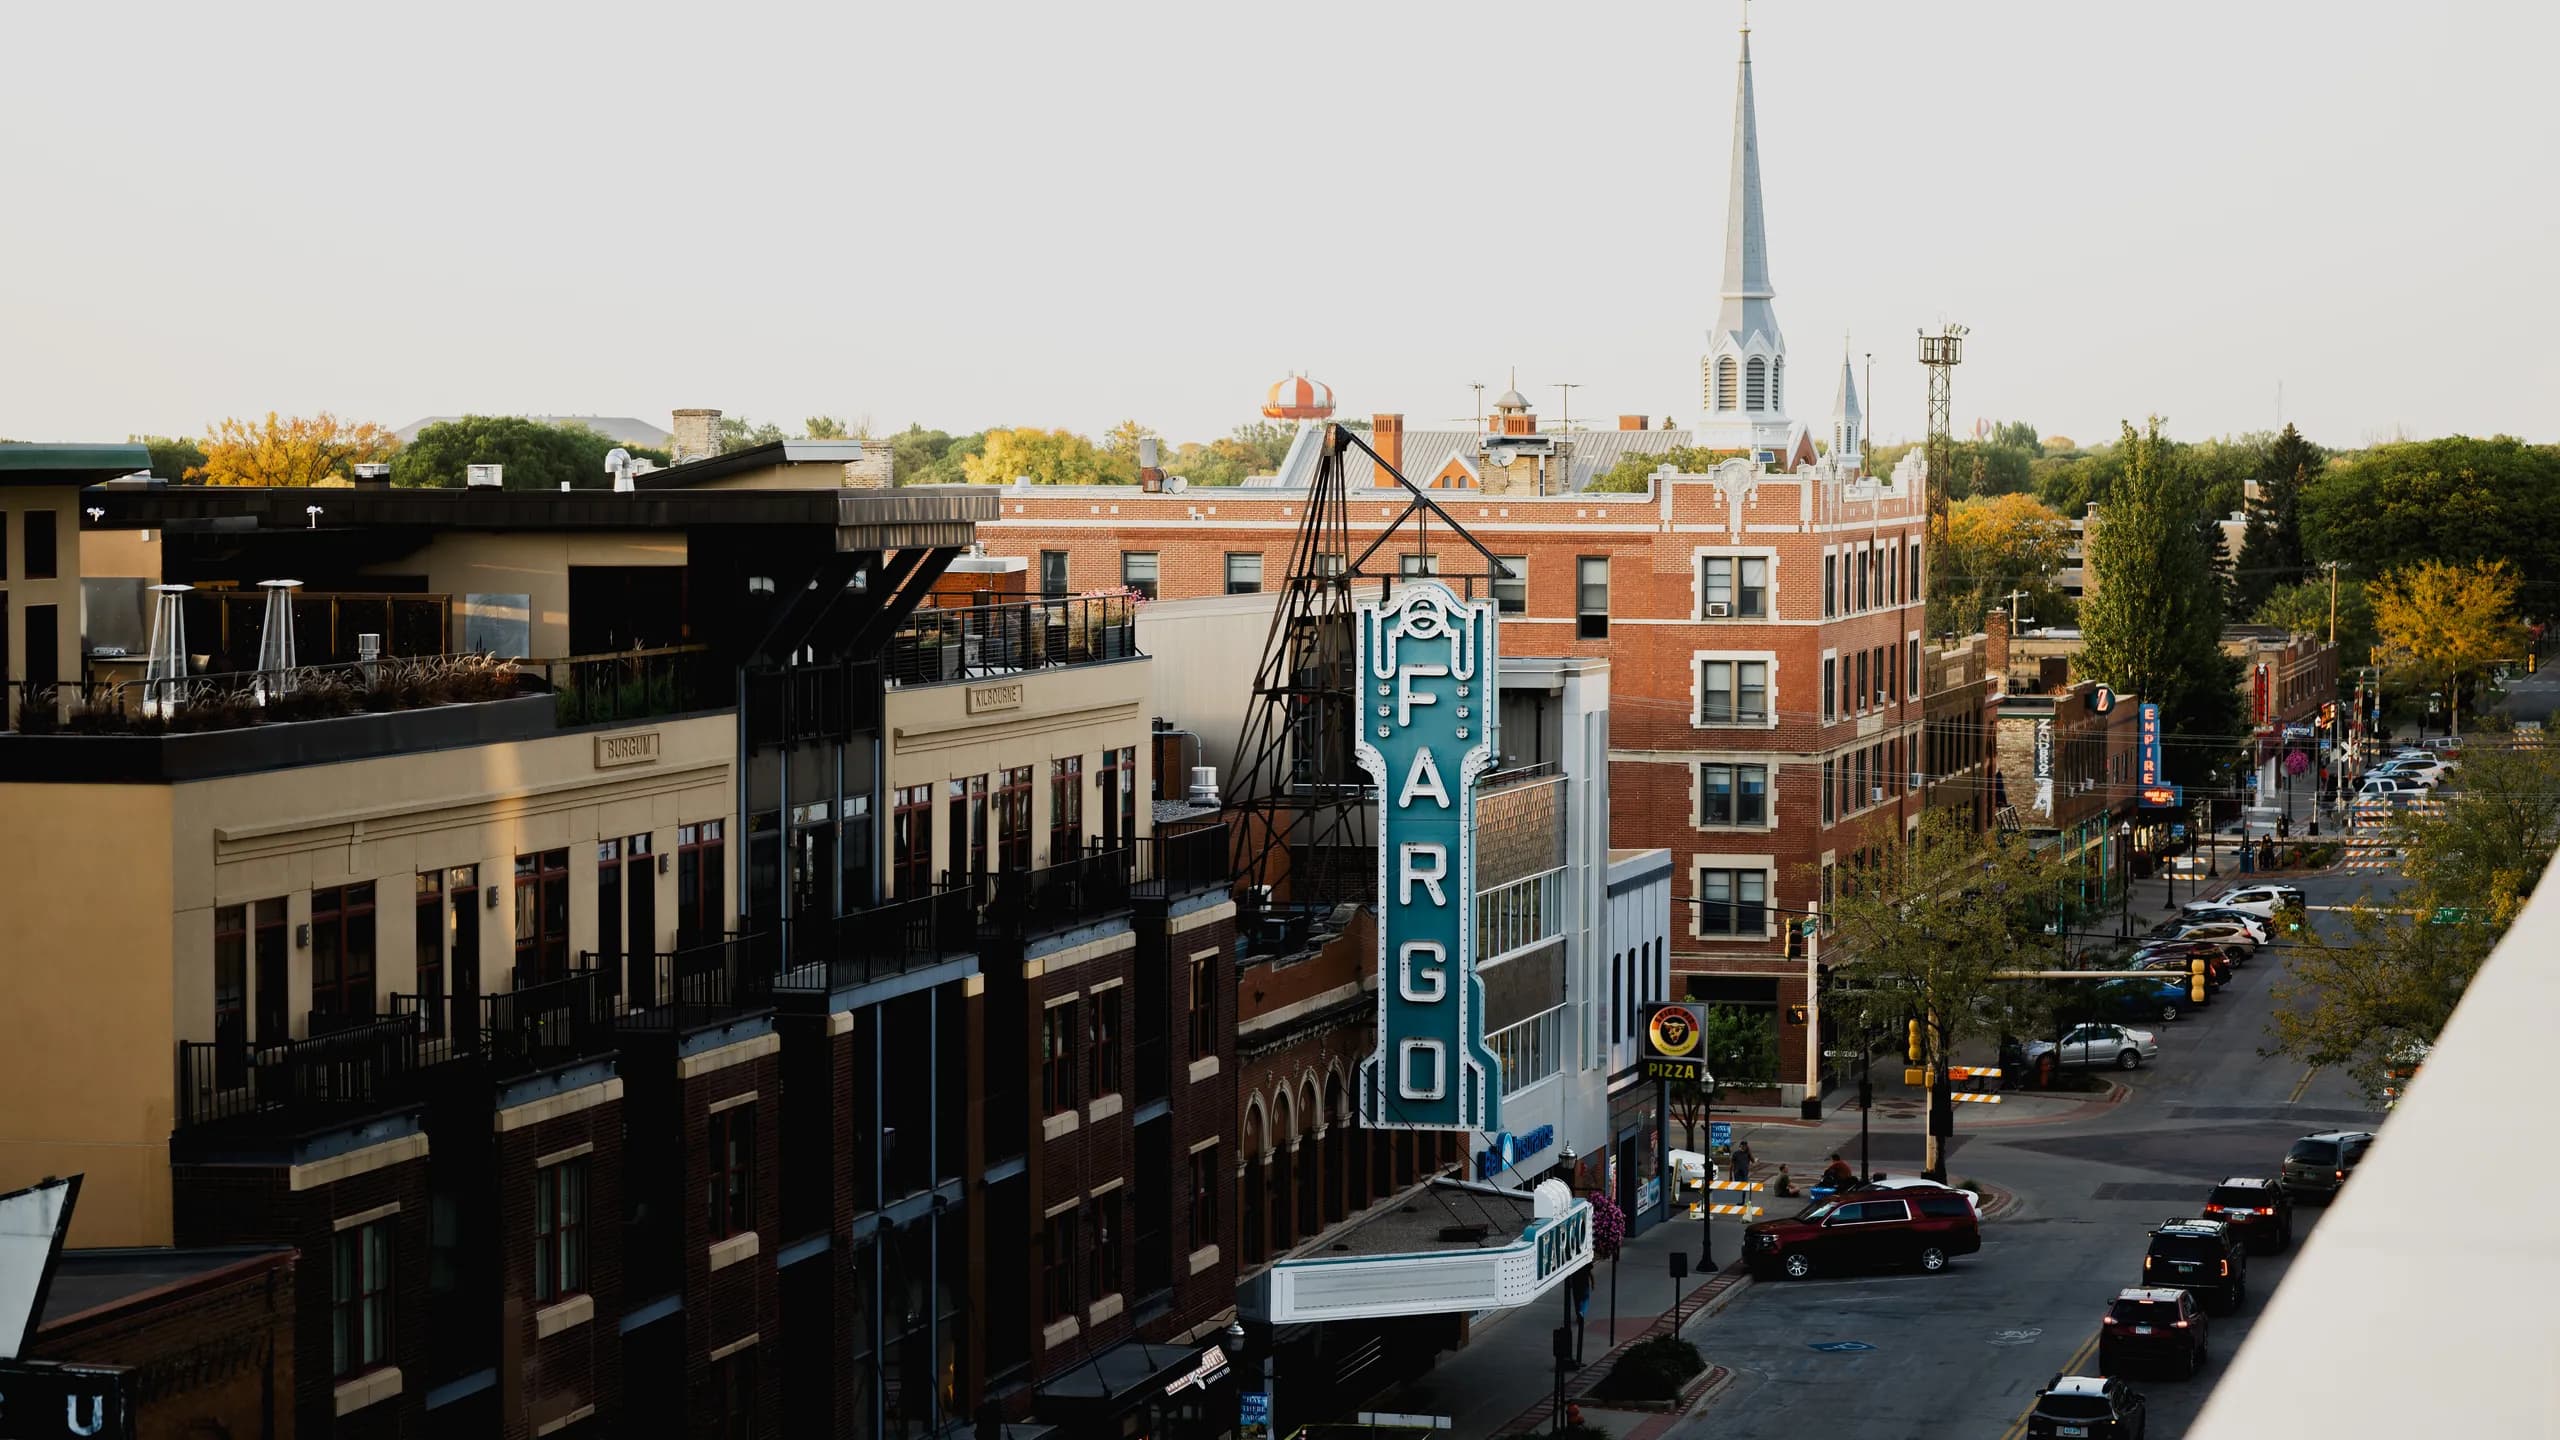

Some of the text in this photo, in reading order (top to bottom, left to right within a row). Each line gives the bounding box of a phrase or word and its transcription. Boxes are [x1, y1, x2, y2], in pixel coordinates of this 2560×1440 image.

[975, 687, 1017, 707] KILBOURNE
[2097, 688, 2109, 712] Z
[607, 735, 651, 759] BURGUM
[2143, 708, 2155, 785] EMPIRE
[1398, 664, 1450, 1100] FARGO
[1648, 1063, 1695, 1079] PIZZA
[1512, 1124, 1554, 1165] Insurance
[1538, 1208, 1588, 1281] FARGO
